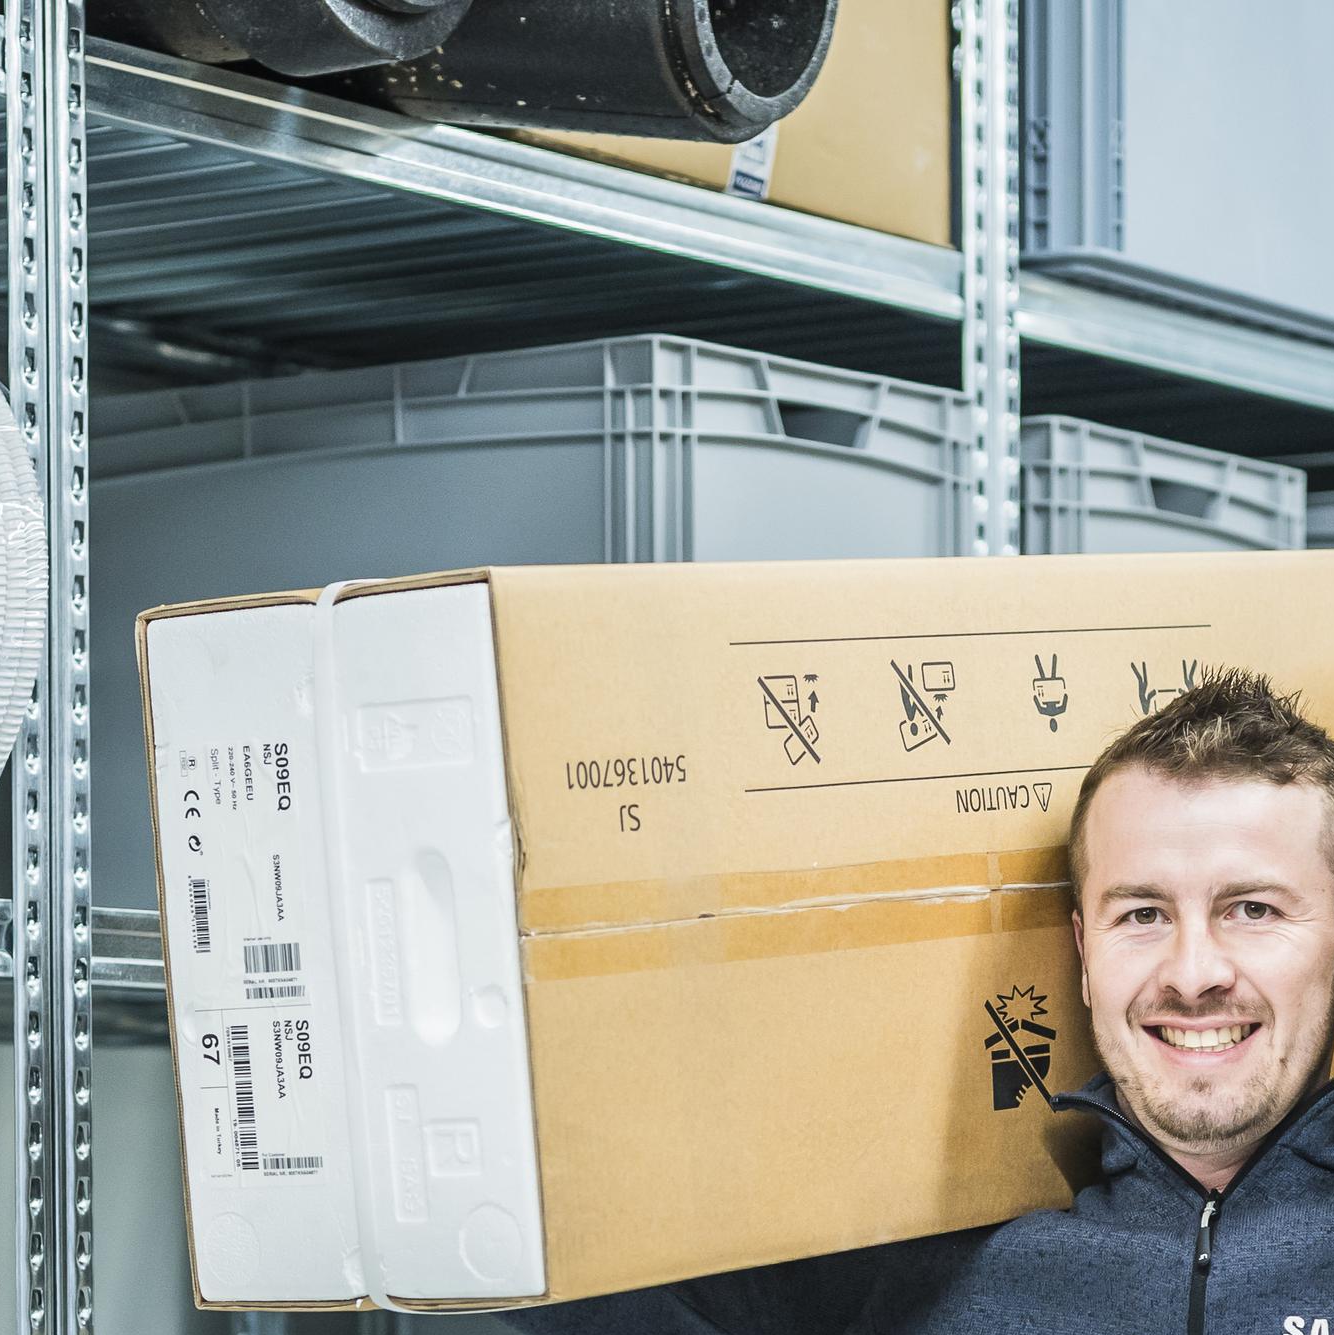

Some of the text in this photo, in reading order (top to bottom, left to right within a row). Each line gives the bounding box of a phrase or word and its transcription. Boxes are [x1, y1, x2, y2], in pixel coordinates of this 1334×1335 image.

[210, 748, 219, 771] Split
[263, 743, 272, 765] NSJ
[274, 742, 291, 811] S09EQ
[566, 754, 688, 790] 5401367001
[213, 780, 221, 805] Type
[956, 784, 1030, 814] CAUTION
[619, 804, 641, 832] SJ
[272, 854, 284, 922] S3NW09JA3AA
[284, 1020, 293, 1041] NSJ
[202, 1033, 221, 1066] 67
[272, 1020, 287, 1099] S3NW09JA3AA
[295, 1019, 313, 1080] S09EQ
